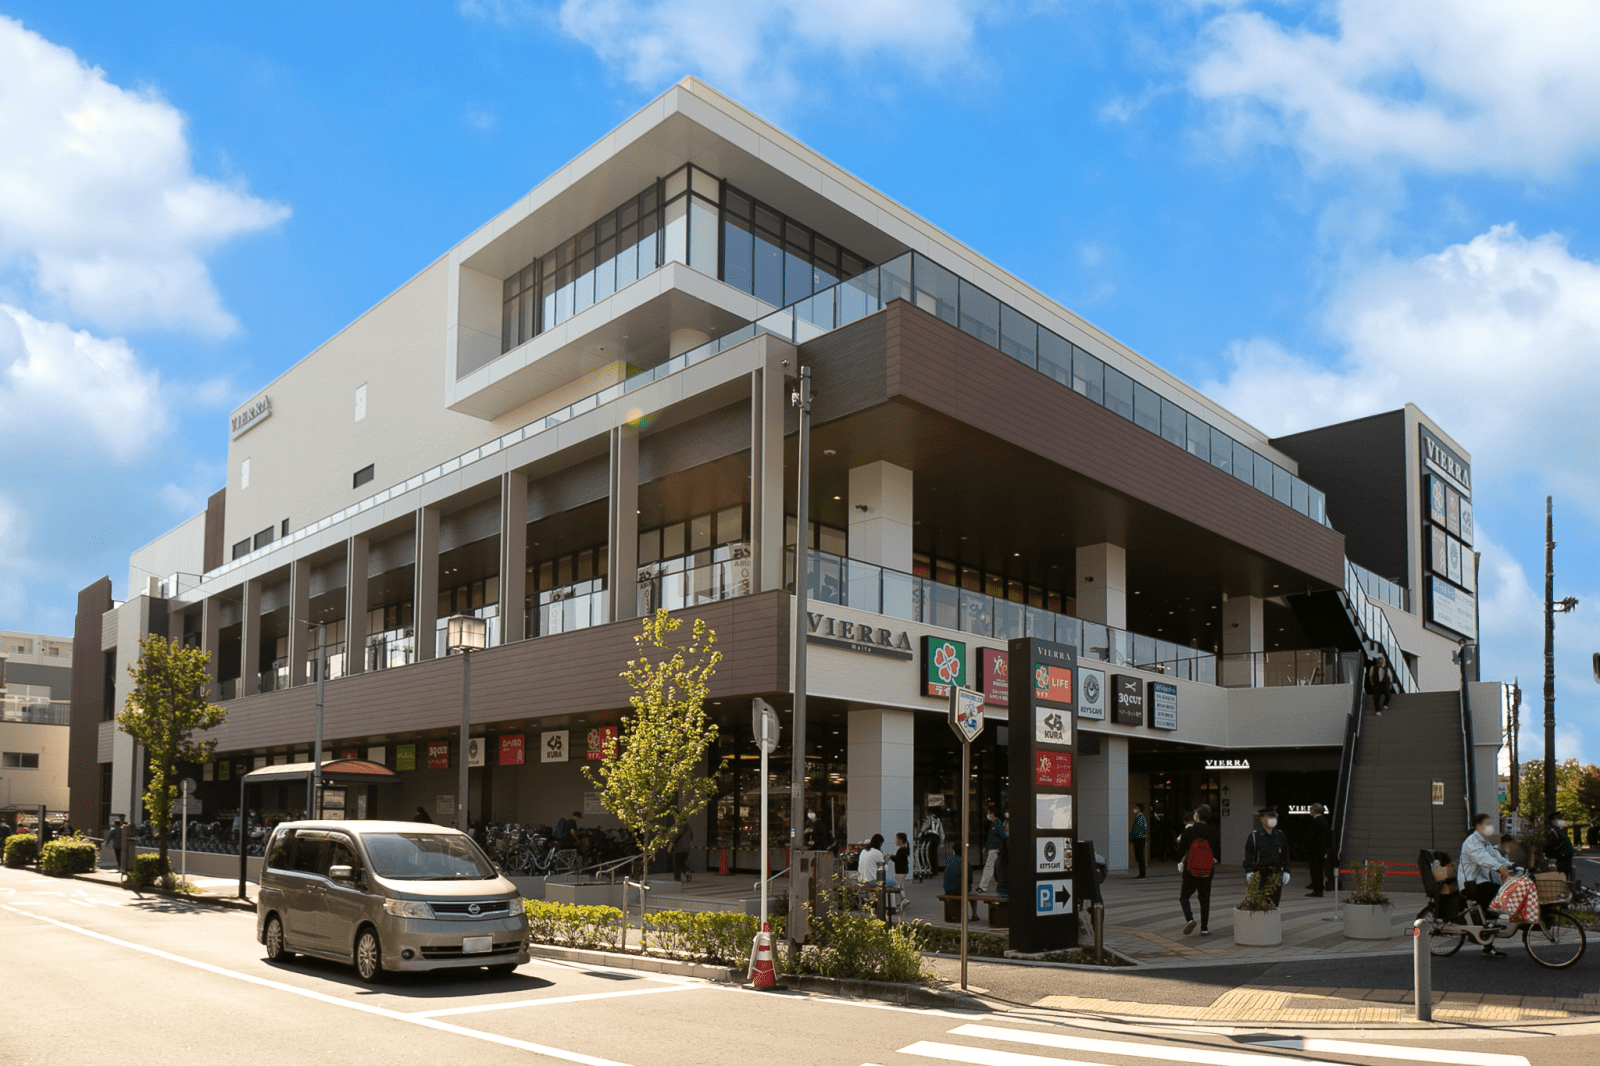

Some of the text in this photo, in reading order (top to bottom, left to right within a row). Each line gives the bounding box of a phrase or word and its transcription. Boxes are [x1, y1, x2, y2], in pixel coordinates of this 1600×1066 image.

[1425, 436, 1470, 489] VIERRA
[806, 611, 913, 651] VIERRA
[1037, 647, 1071, 661] VIERRA
[1051, 677, 1069, 689] LIFE
[1044, 730, 1063, 740] KURA
[546, 750, 562, 759] KURA
[1205, 759, 1250, 767] VIERRA
[1040, 889, 1050, 908] P
